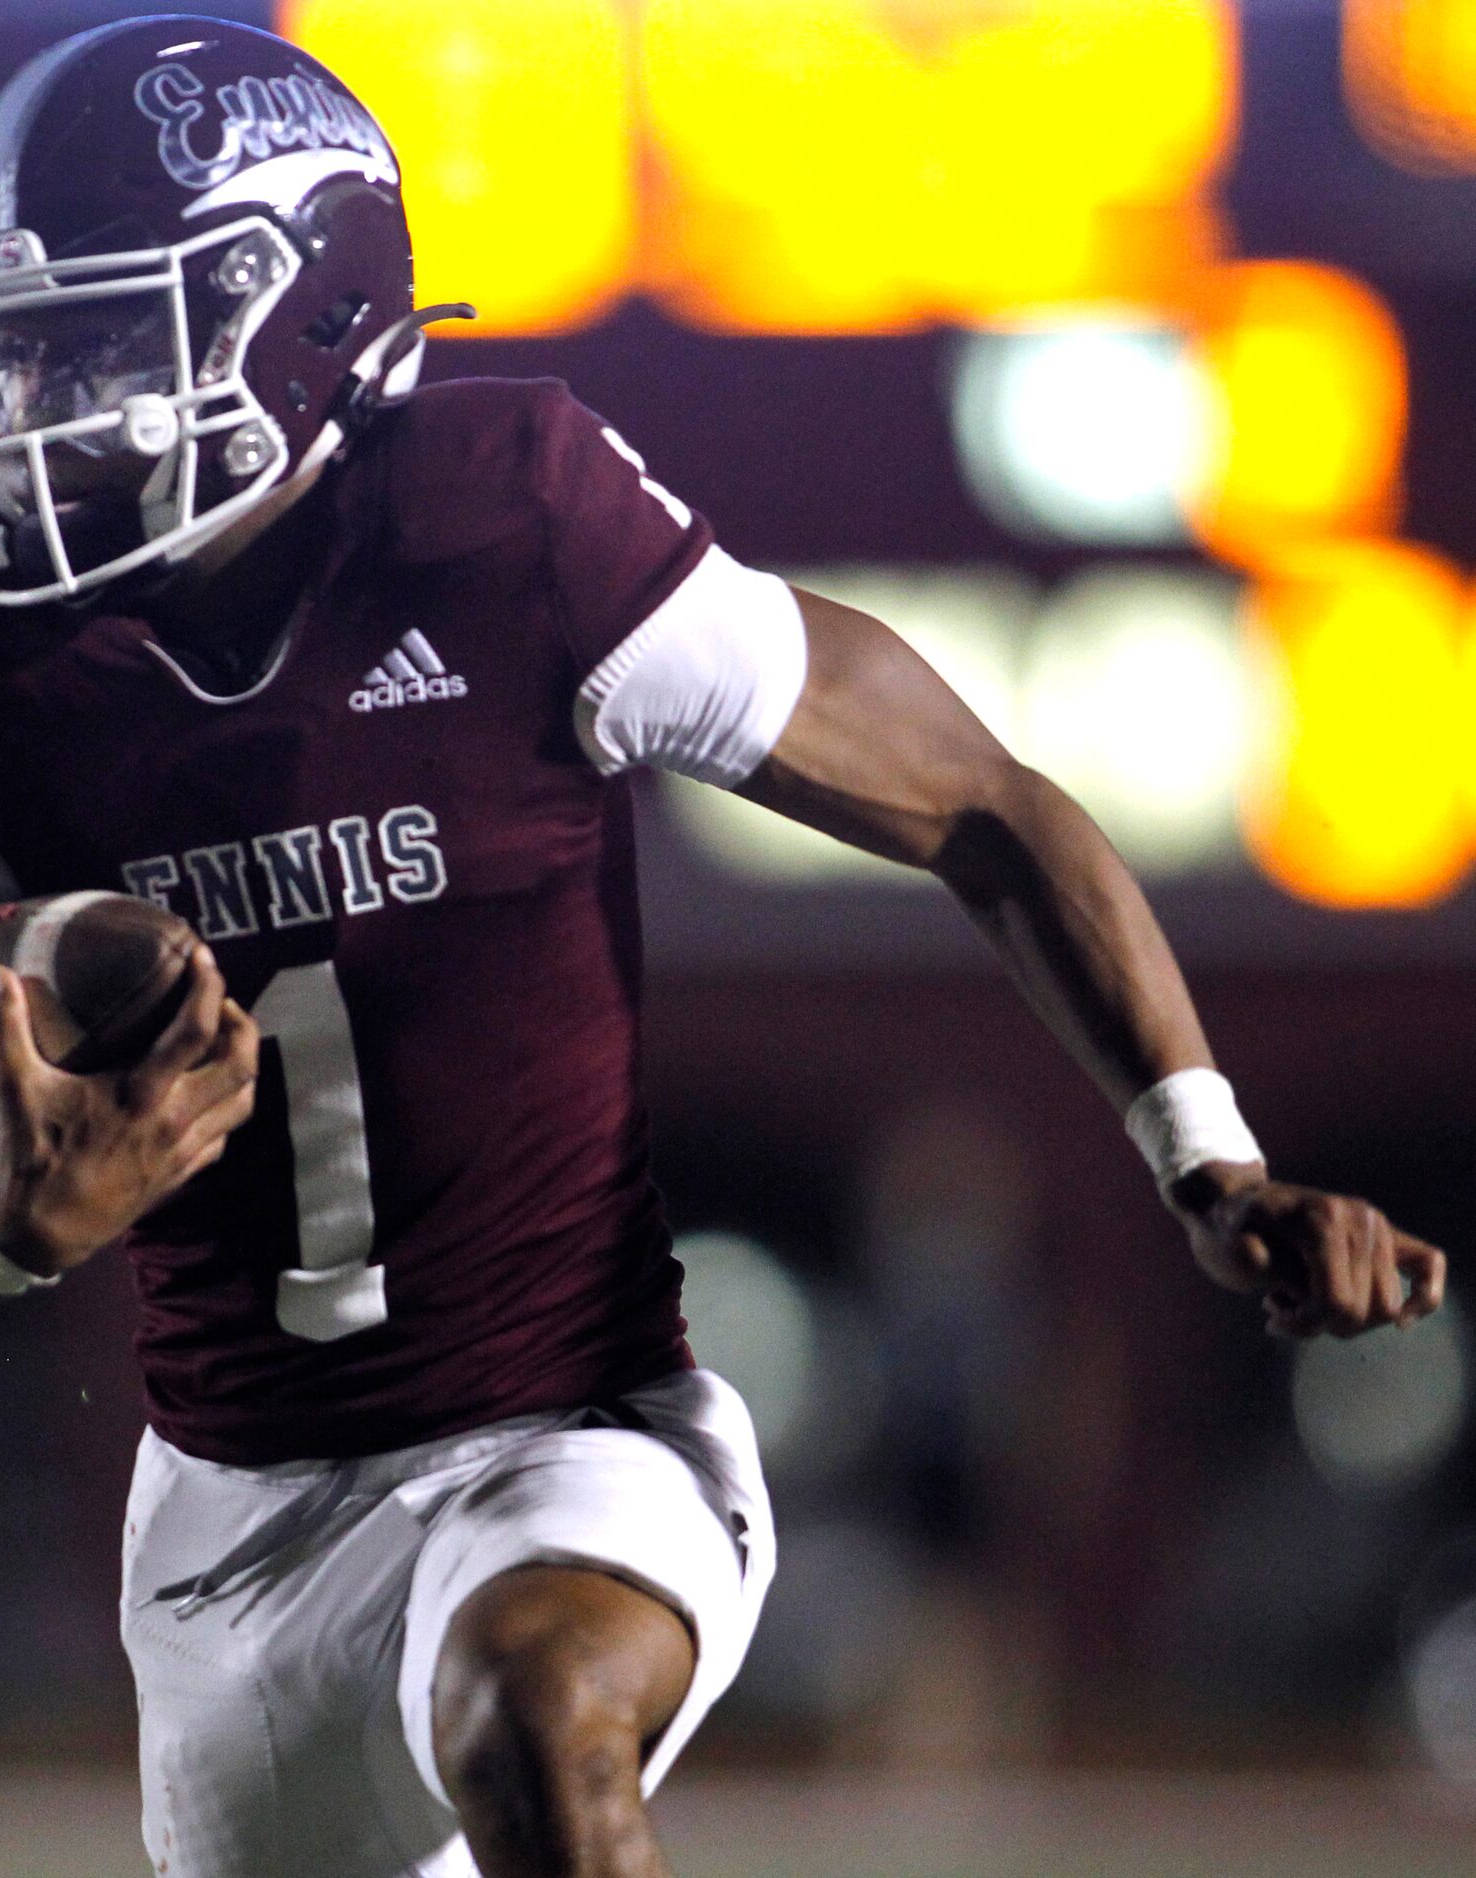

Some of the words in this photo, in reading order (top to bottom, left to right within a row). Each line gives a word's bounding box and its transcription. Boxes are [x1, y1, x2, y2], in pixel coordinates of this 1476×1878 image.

[348, 671, 468, 713] adidas
[122, 804, 449, 940] ENNIS
[253, 959, 388, 1343] 1
